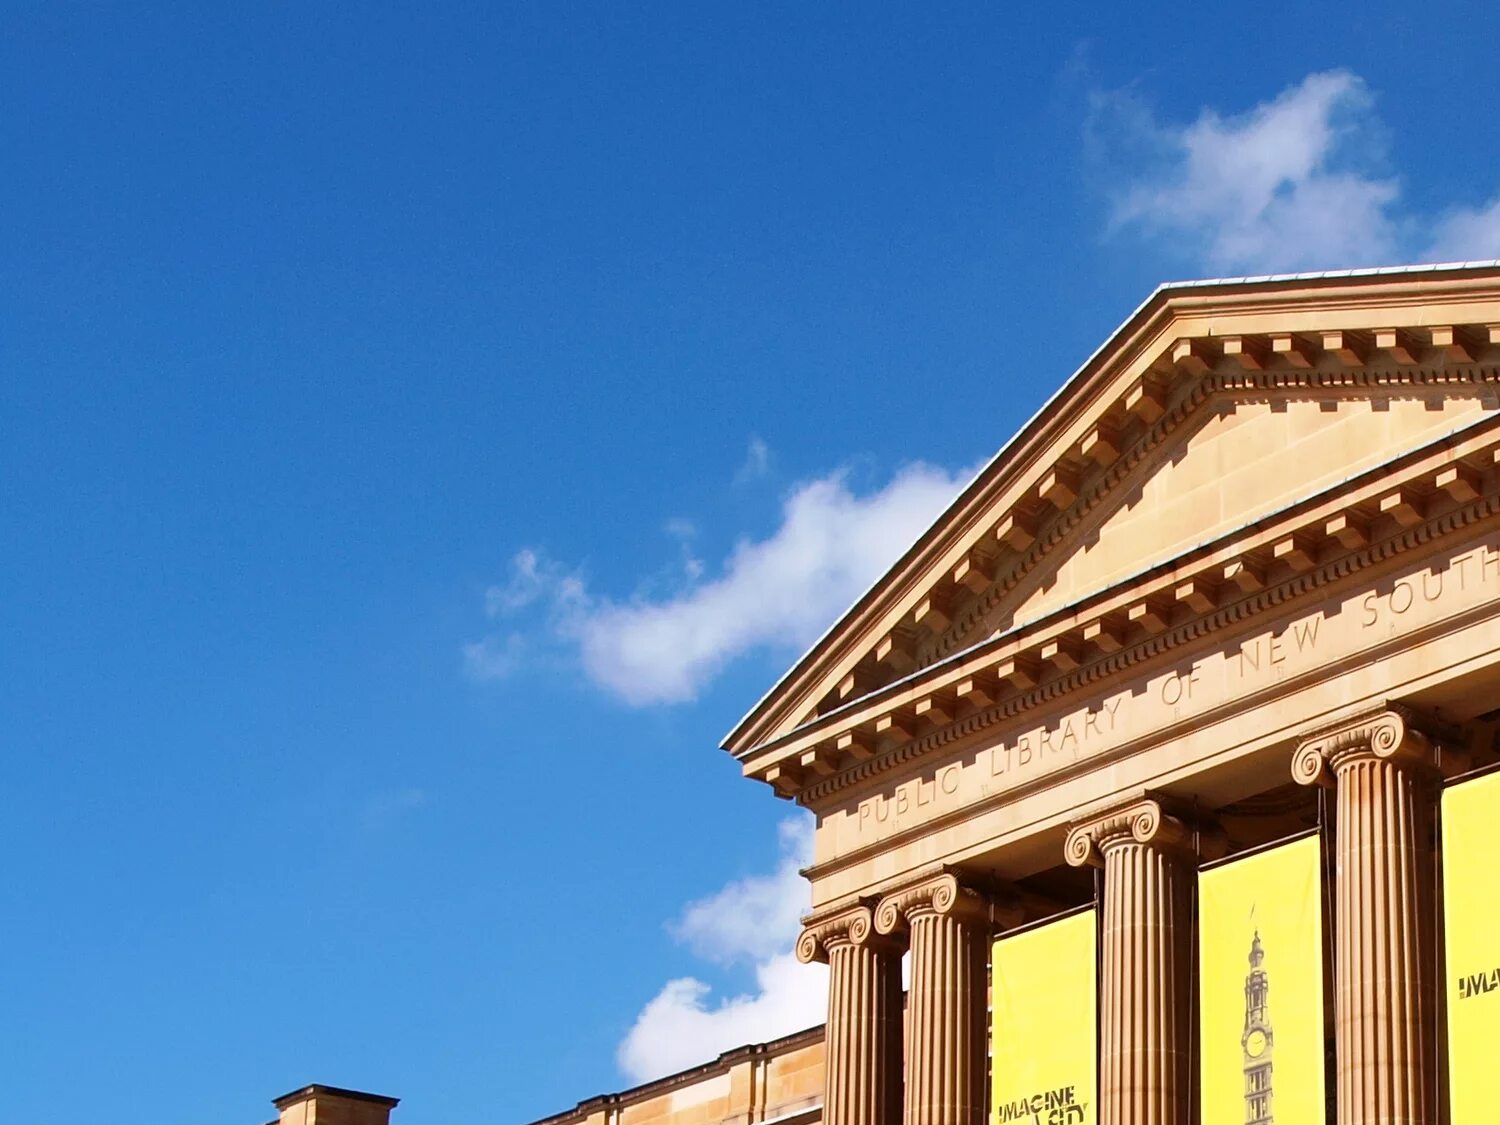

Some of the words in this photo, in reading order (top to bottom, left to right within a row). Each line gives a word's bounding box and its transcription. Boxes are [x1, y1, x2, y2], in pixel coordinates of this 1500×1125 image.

[858, 767, 960, 832] PUBLIC
[990, 698, 1122, 778] LIBRARY
[1161, 665, 1201, 706] OF
[1240, 616, 1321, 678] NEW
[999, 1086, 1075, 1124] IMAGINE
